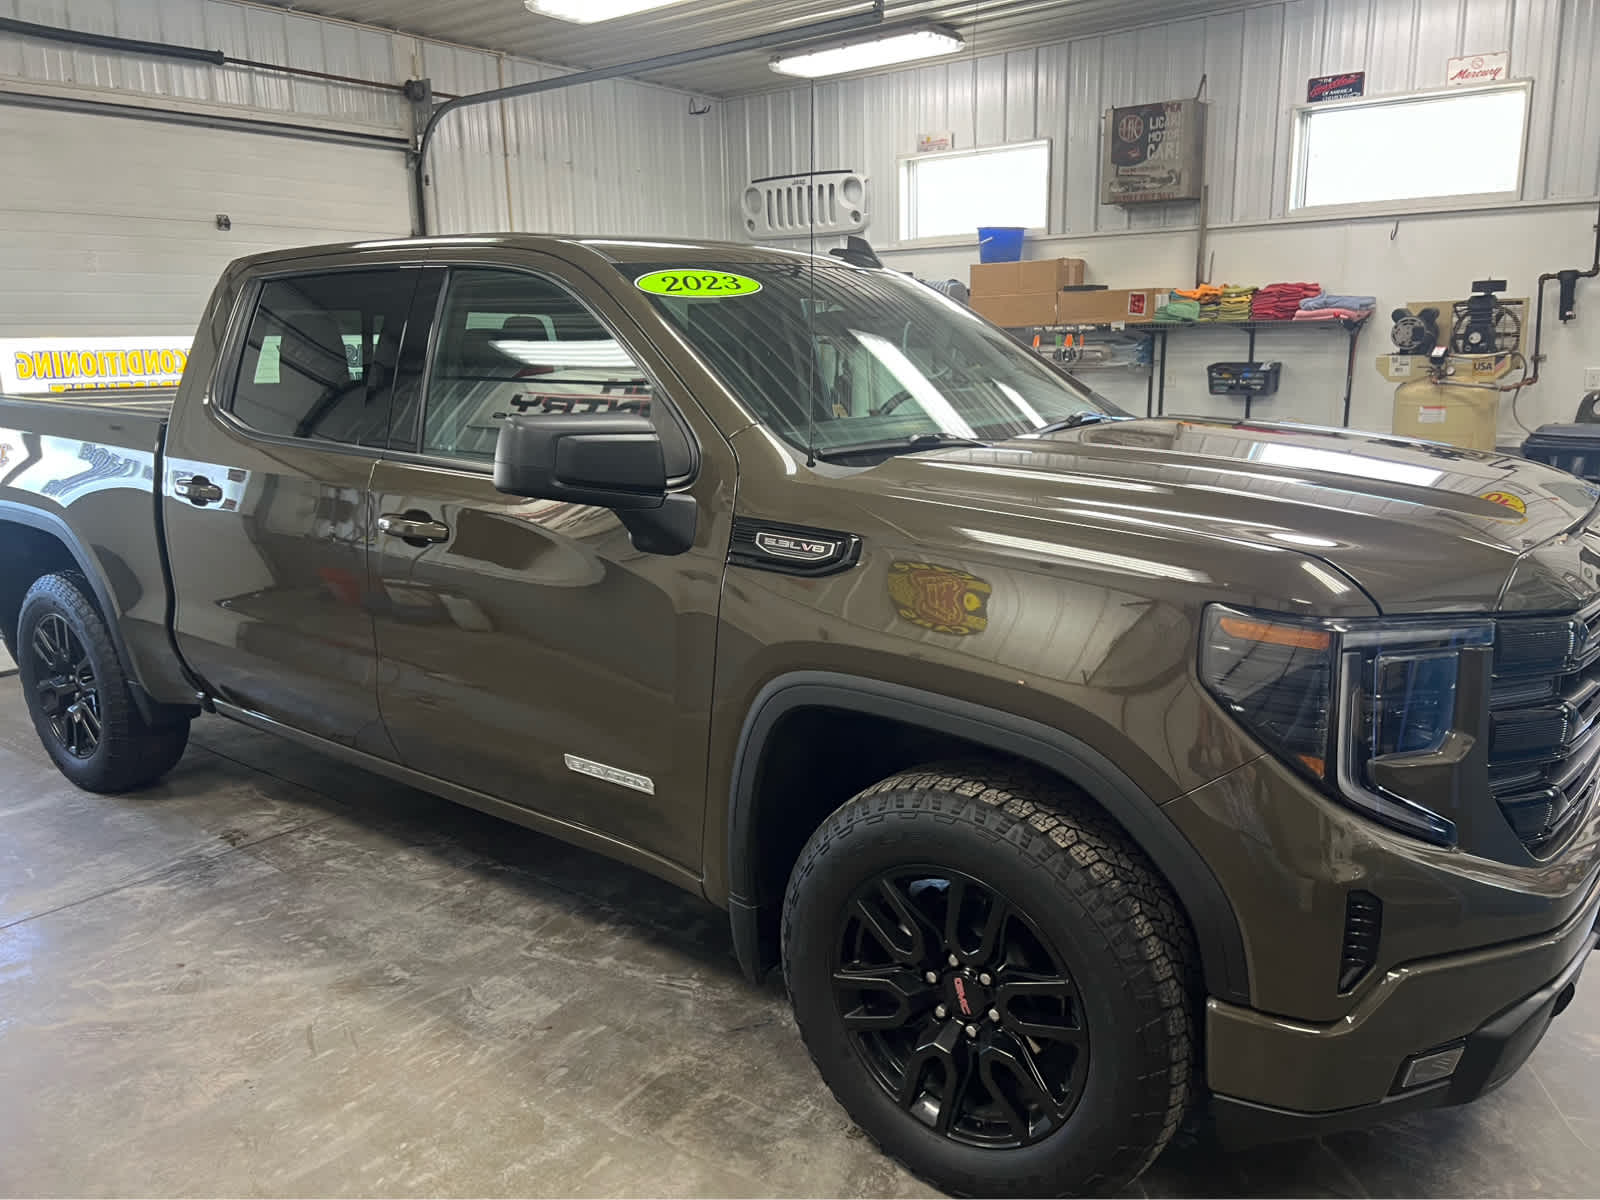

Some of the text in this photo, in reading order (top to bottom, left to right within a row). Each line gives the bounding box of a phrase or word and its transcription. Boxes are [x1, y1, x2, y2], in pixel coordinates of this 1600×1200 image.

[1449, 66, 1503, 81] Mercury
[661, 275, 742, 293] 2023
[1474, 362, 1493, 371] USA
